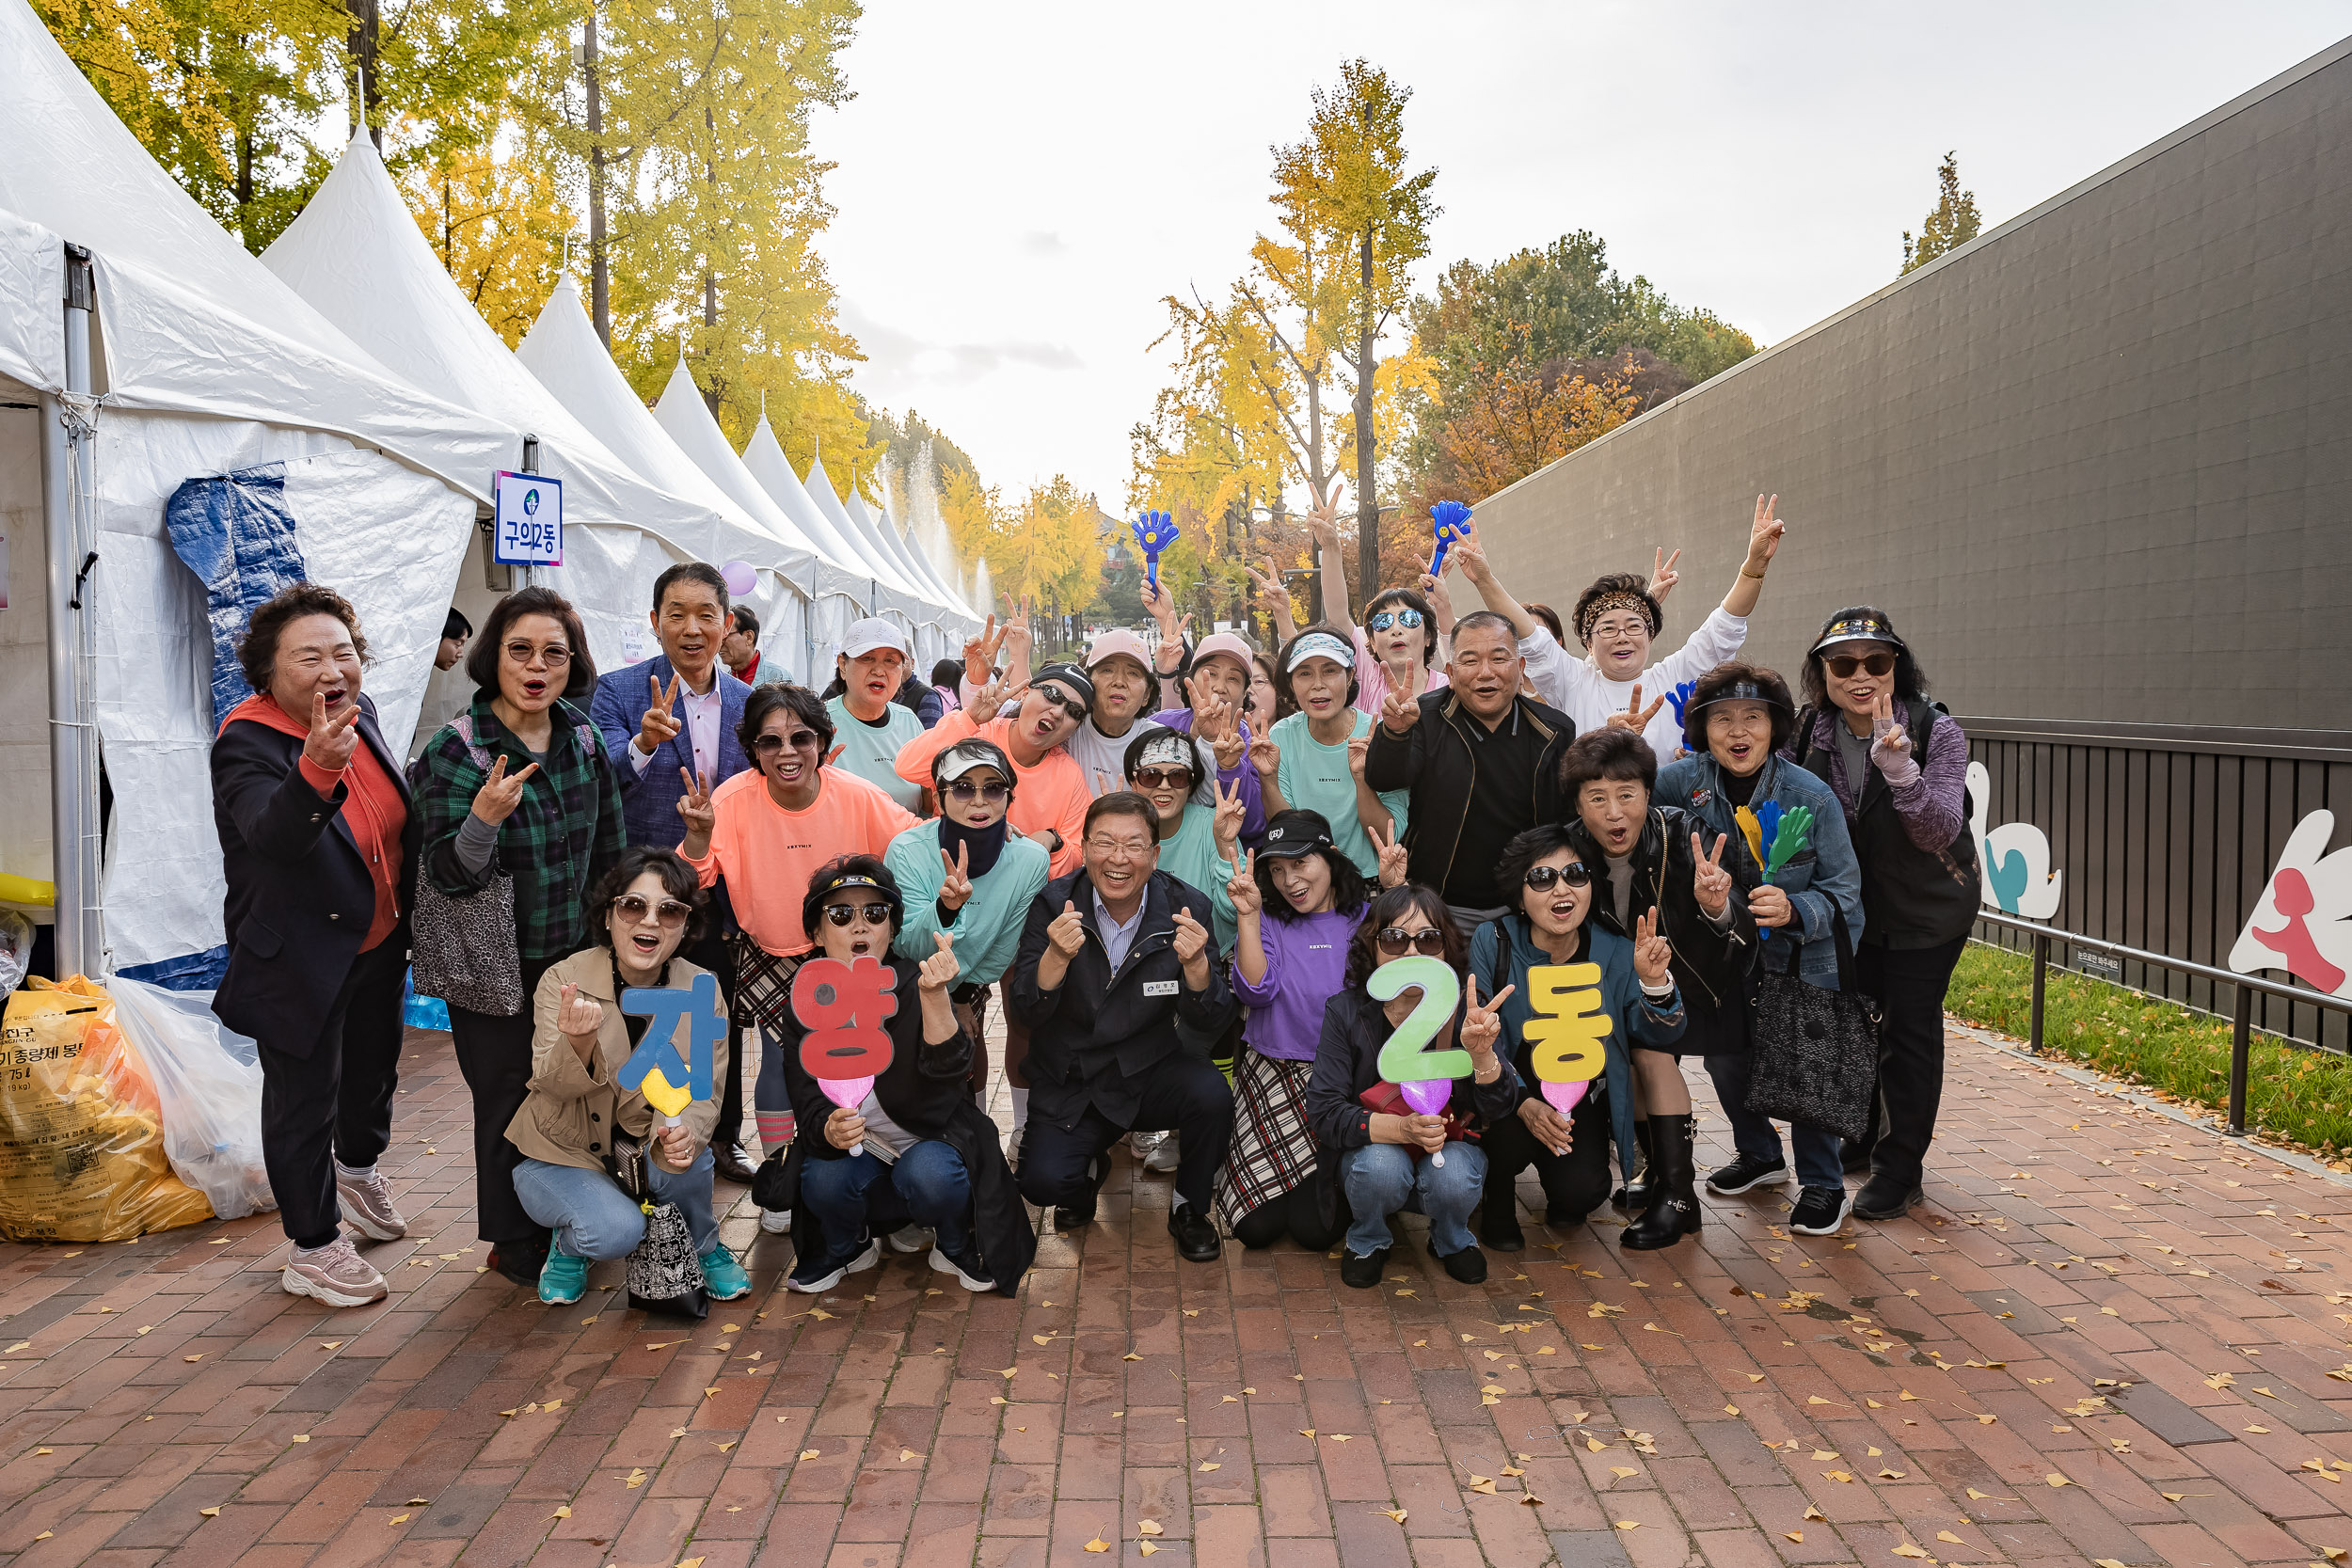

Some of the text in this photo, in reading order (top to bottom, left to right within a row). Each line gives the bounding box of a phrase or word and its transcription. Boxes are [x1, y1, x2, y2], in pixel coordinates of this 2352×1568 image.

[505, 521, 555, 553] 구의2동
[2077, 950, 2098, 964] 눈으로만
[14, 1045, 59, 1065] 종량제
[8, 1069, 23, 1081] 75
